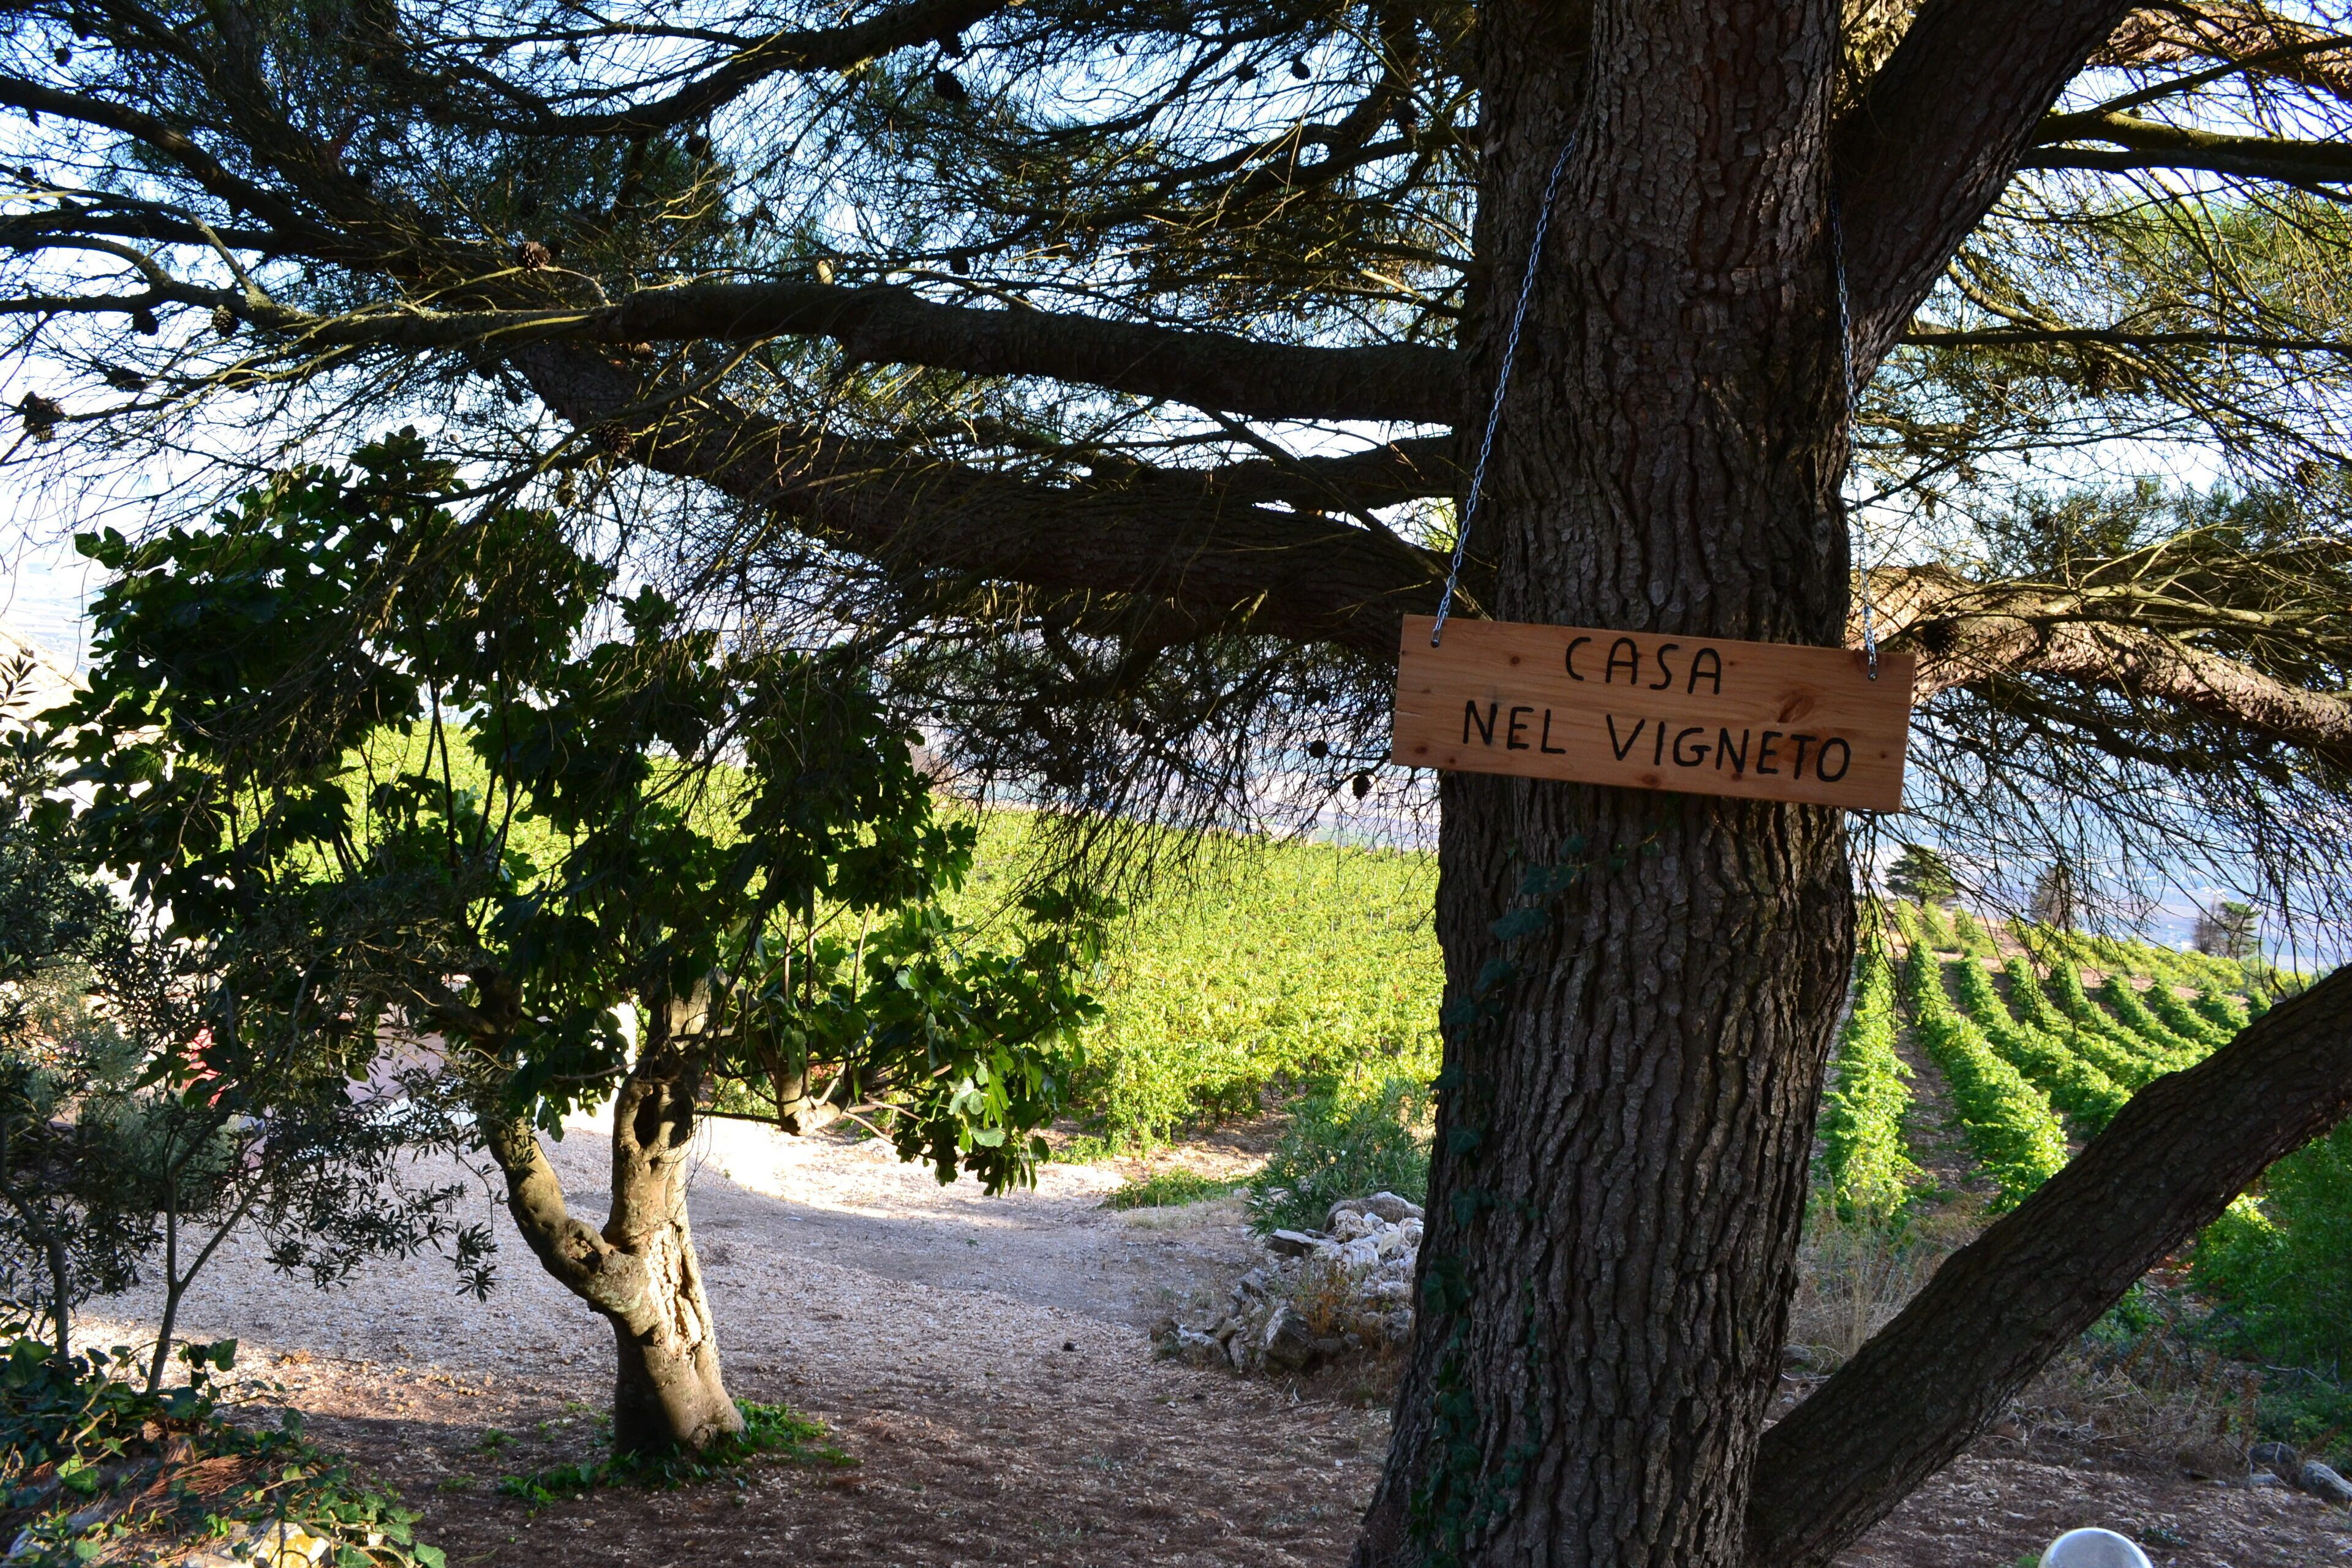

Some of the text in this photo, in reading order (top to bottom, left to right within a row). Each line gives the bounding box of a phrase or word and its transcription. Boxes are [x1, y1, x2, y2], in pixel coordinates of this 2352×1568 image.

[1566, 636, 1722, 695] CASA
[1463, 700, 1851, 783] NEL VIGNETO
